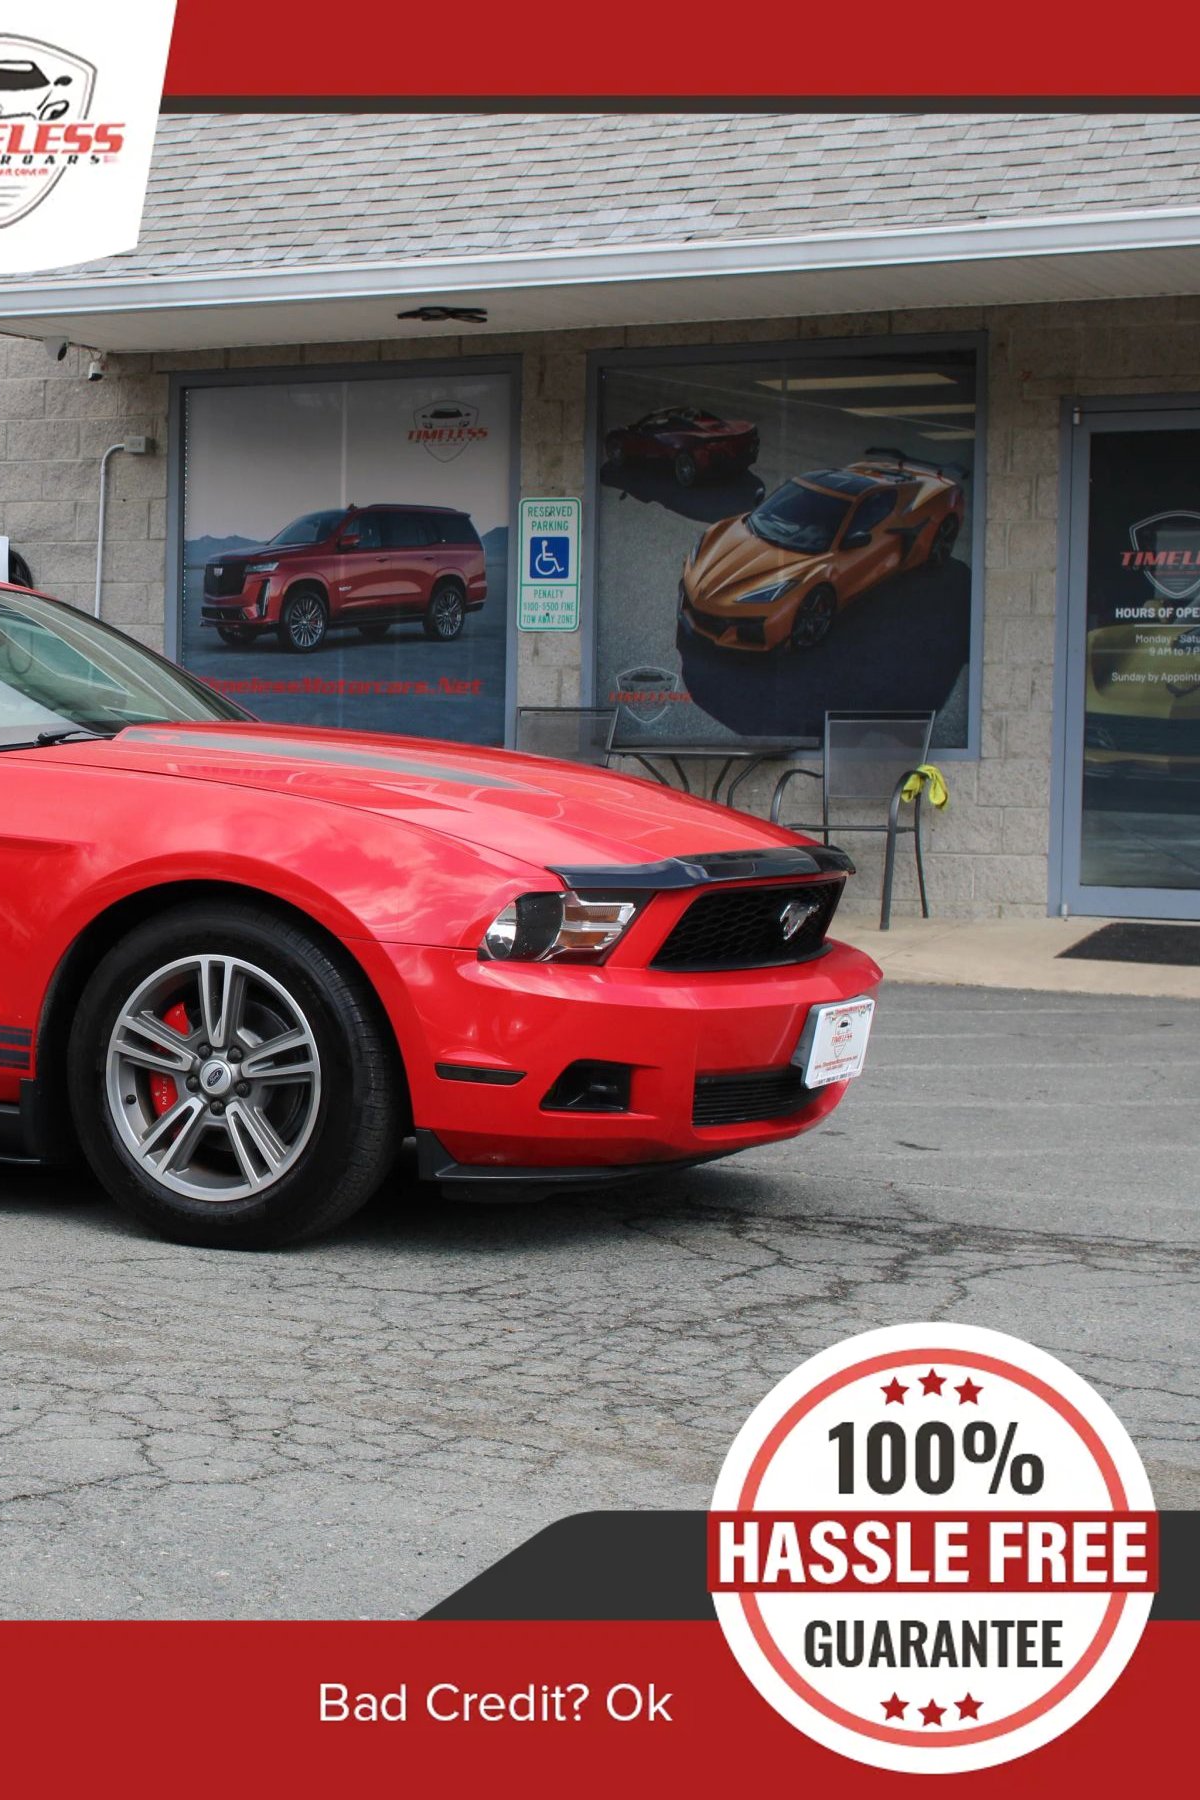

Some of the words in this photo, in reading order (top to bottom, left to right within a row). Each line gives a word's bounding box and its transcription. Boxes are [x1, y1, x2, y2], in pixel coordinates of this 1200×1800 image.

[527, 506, 573, 517] RESERVED
[531, 520, 569, 532] PARKING
[533, 589, 564, 599] PENALTY
[561, 601, 575, 611] FINE
[1115, 607, 1156, 619] HOURS
[1158, 607, 1173, 619] OF
[523, 614, 536, 624] TOW
[538, 614, 555, 624] AWAY
[557, 614, 575, 624] ZONE
[1135, 634, 1172, 646] Monday
[1157, 646, 1172, 657] AM
[1174, 647, 1184, 657] to
[1111, 672, 1146, 684] Sunday
[1148, 672, 1159, 684] by
